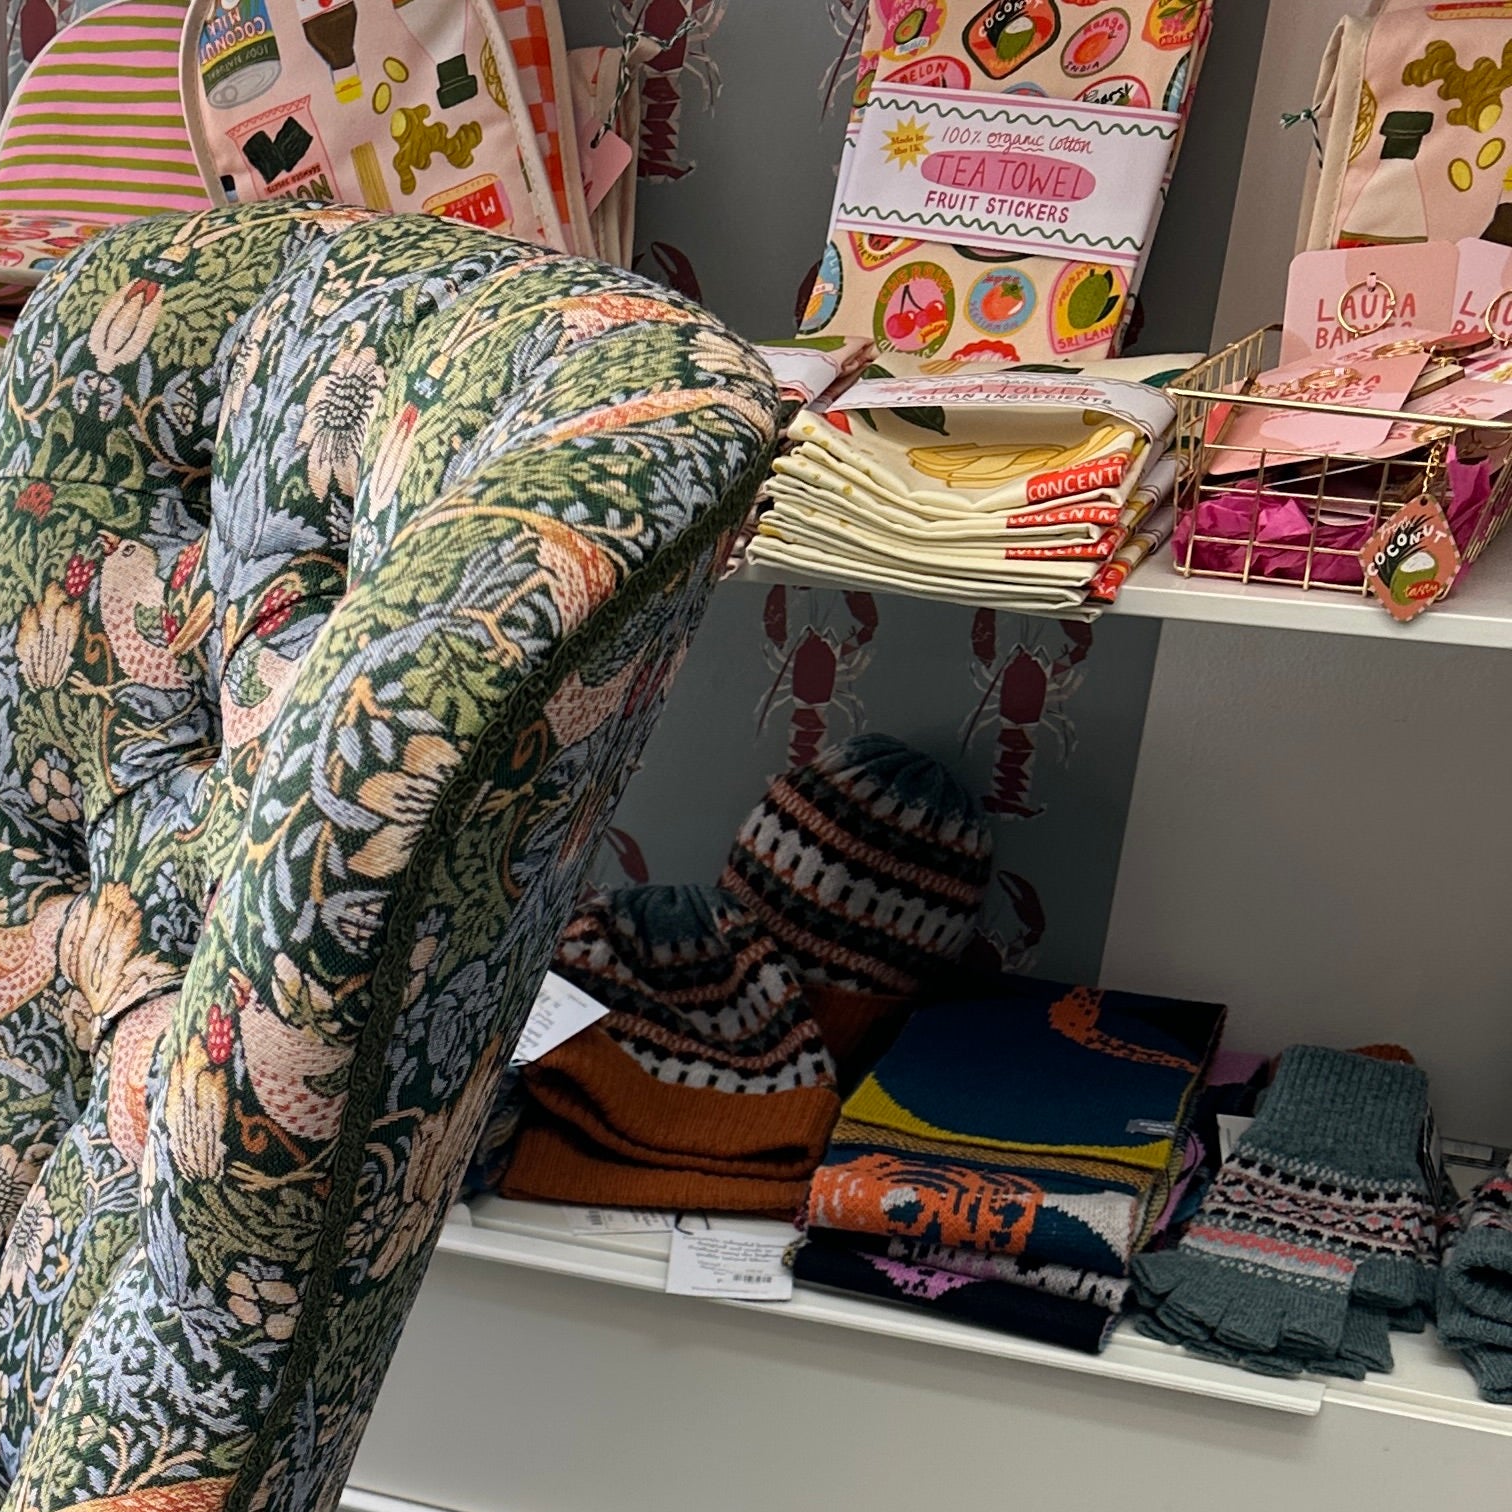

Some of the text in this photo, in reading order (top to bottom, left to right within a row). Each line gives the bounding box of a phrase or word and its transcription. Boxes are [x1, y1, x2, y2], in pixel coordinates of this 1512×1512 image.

[1064, 61, 1100, 73] INDIA
[941, 126, 1094, 155] 100% organic cotton
[936, 154, 1085, 200] TEA TOWEL
[925, 190, 1070, 224] FRUIT STICKERS
[1317, 292, 1416, 322] LAURA
[1057, 334, 1079, 350] SRI
[1368, 524, 1447, 576] COCONUT
